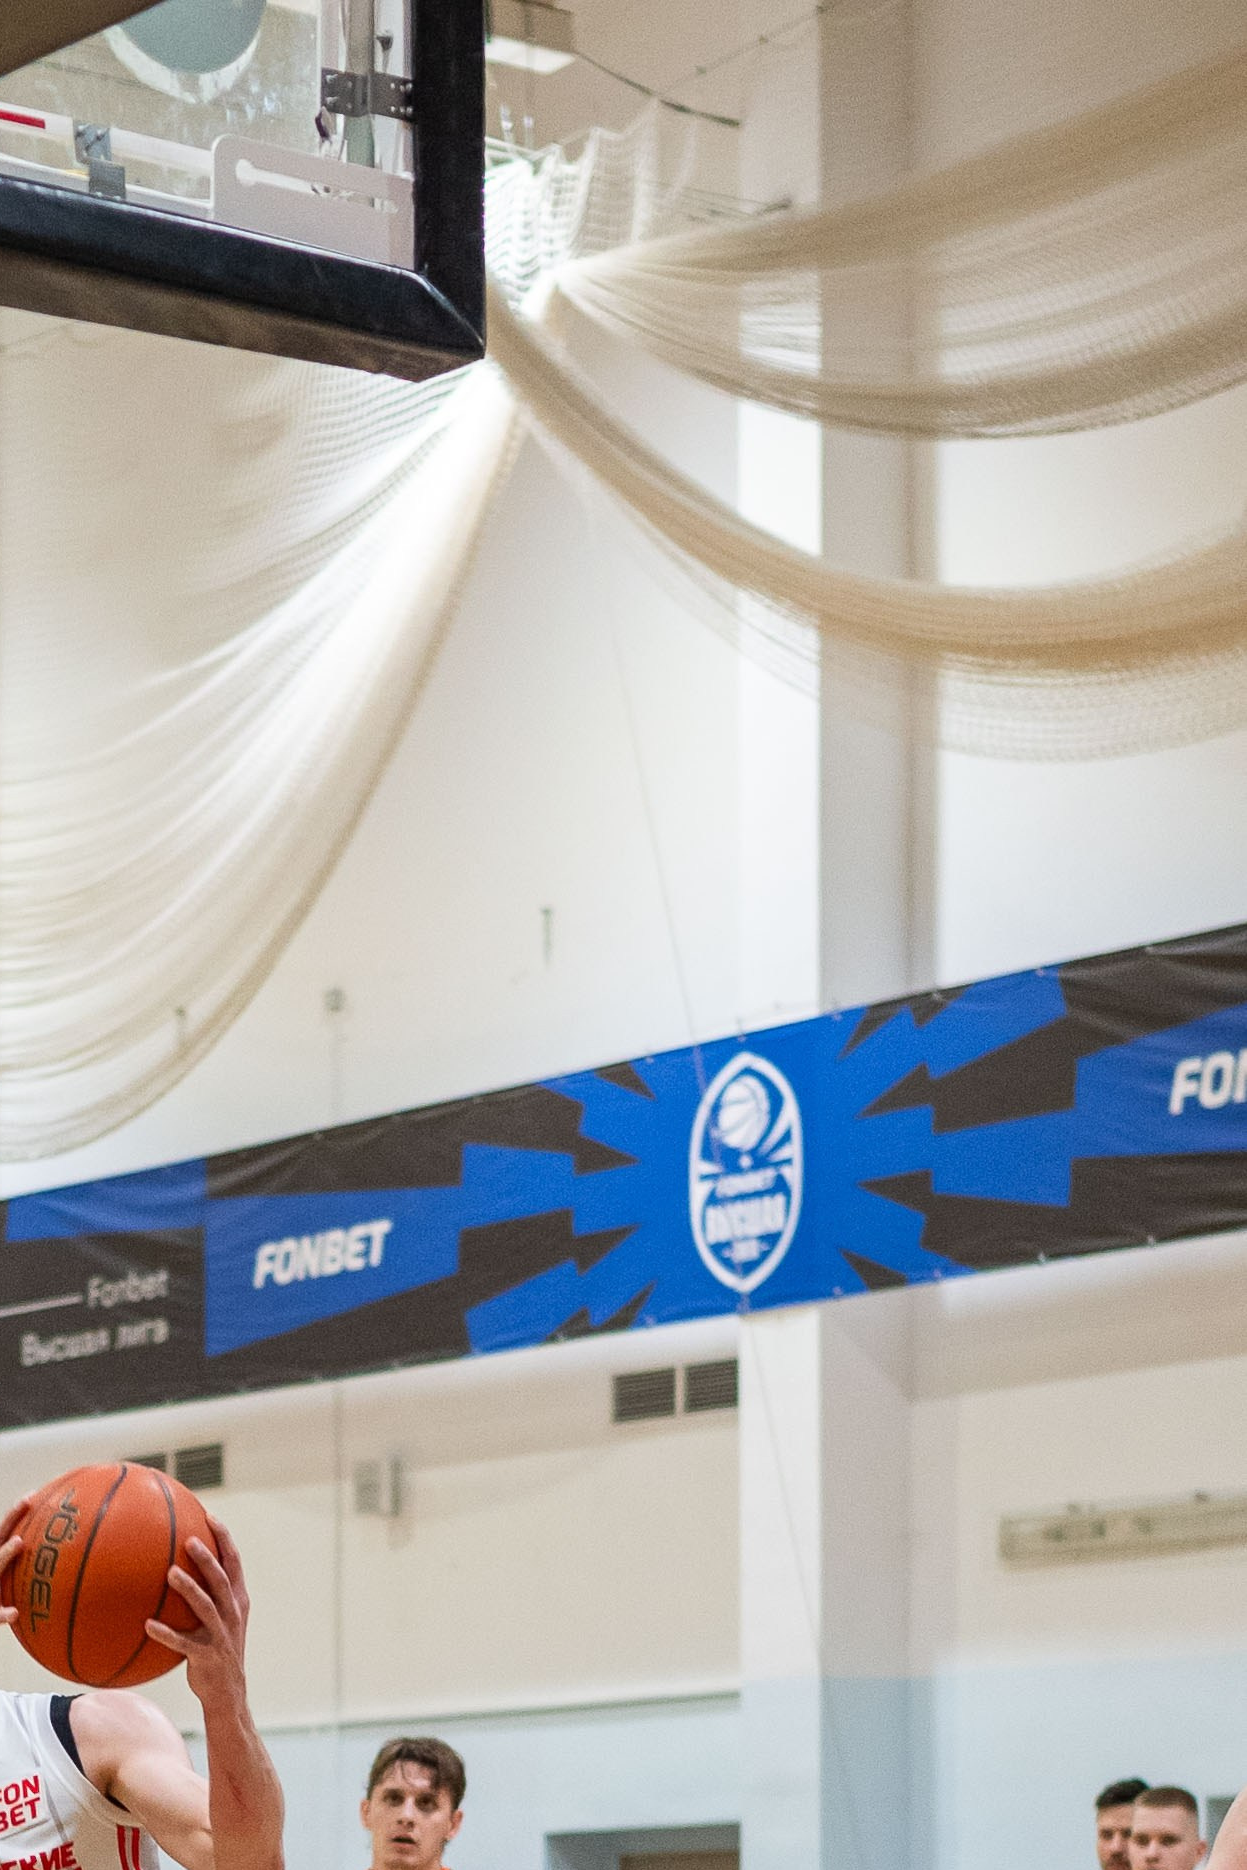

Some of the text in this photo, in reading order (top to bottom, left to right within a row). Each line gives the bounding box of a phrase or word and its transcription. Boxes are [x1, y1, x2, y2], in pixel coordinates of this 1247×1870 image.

[252, 1218, 393, 1290] FONBET
[87, 1269, 169, 1309] Fonbet
[19, 1317, 170, 1367] Высшая лига
